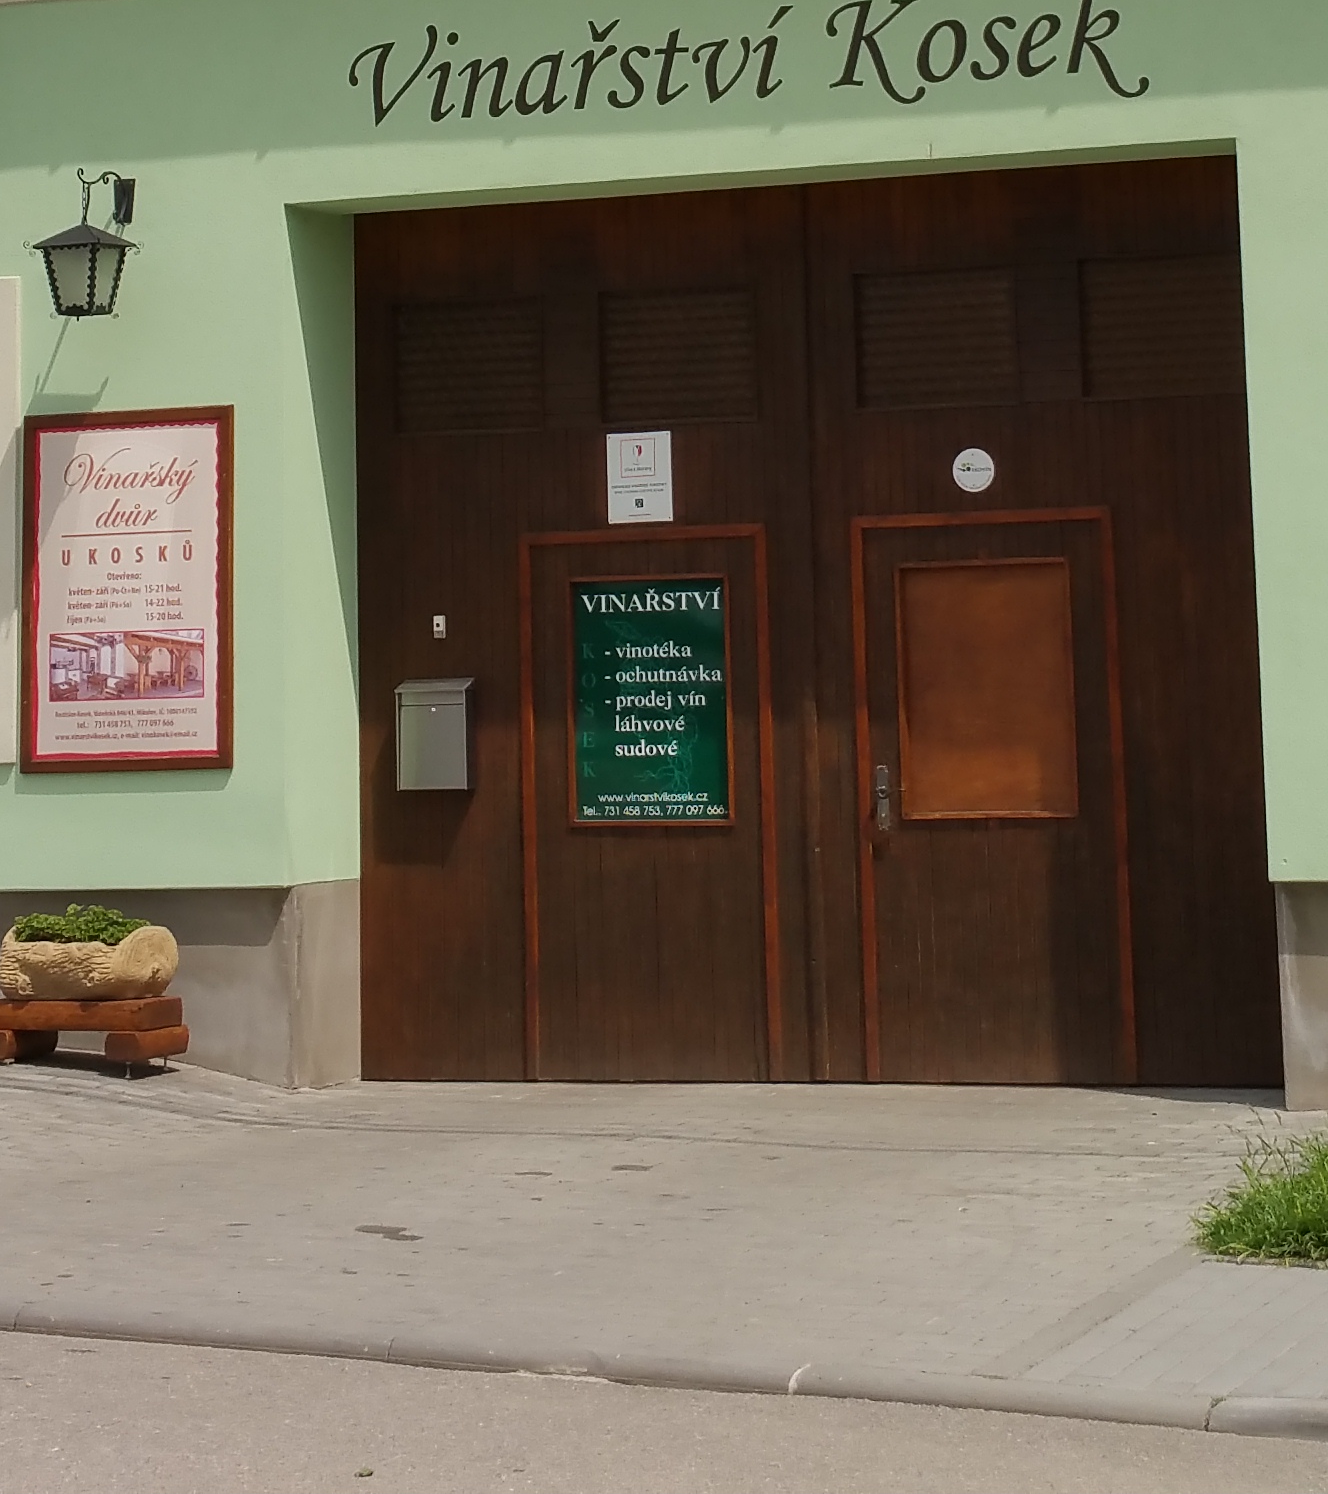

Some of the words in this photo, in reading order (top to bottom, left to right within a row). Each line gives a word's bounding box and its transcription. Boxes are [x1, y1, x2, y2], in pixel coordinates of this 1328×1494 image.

[347, 5, 793, 128] Vinařství
[63, 447, 199, 505] Vinařský
[95, 498, 158, 529] dvůr
[145, 584, 164, 593] 15-21
[581, 587, 721, 614] VINAŘSTVÍ
[615, 640, 692, 659] vinotéka
[615, 664, 723, 684] ochutnávka
[615, 690, 673, 710] prodej
[678, 691, 707, 707] vín
[614, 714, 685, 733] láhvové
[614, 739, 678, 758] sudové
[604, 805, 620, 816] 731
[622, 805, 641, 816] 458
[665, 805, 684, 815] 777
[685, 804, 704, 815] 097
